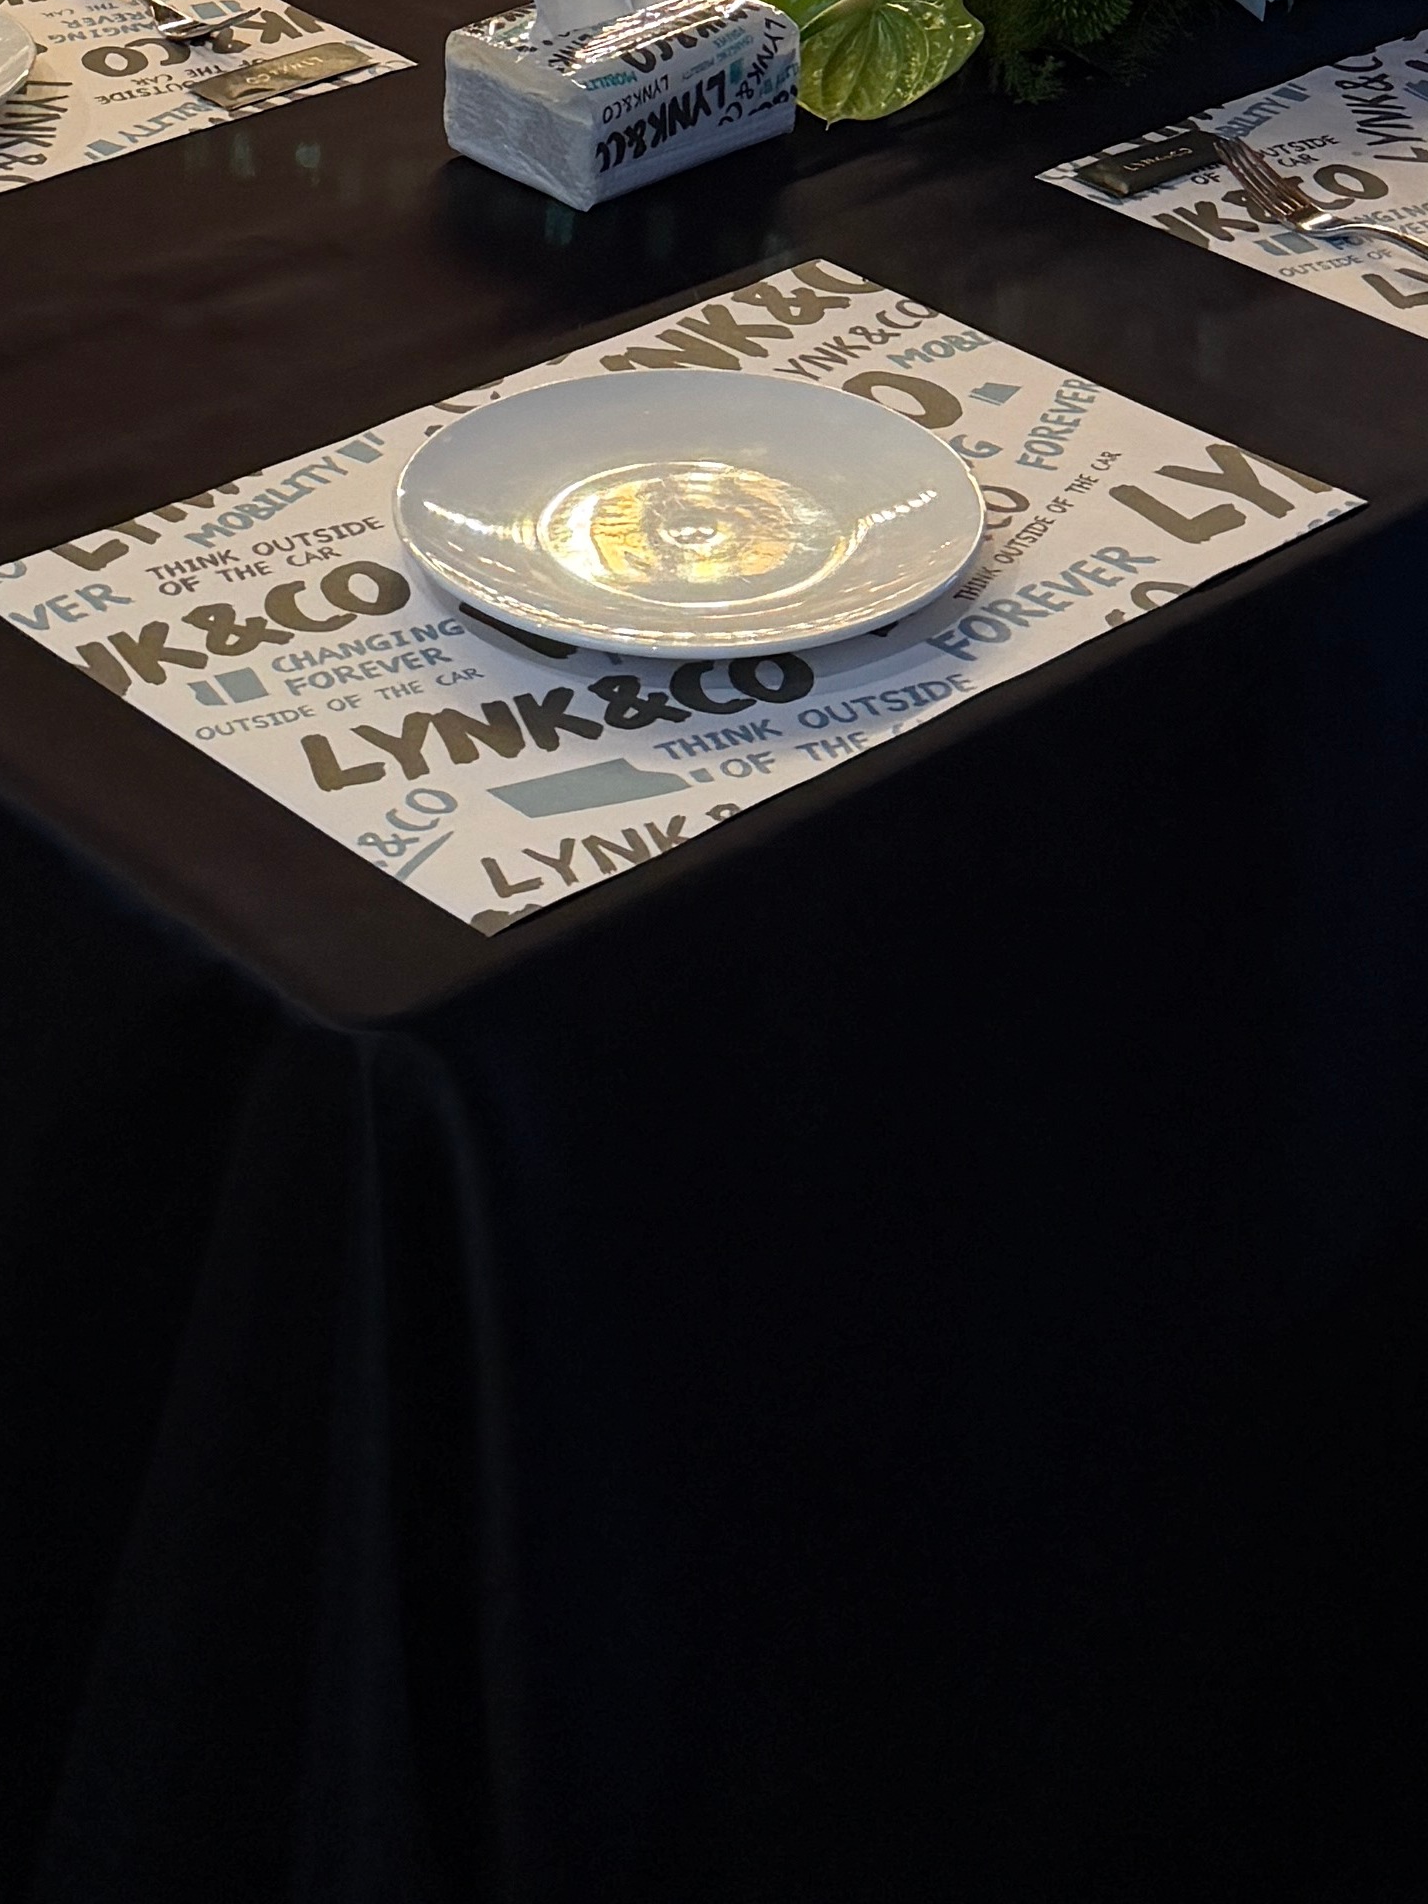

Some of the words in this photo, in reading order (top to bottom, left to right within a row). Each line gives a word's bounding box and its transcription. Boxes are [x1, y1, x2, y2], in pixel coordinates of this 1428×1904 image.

[602, 73, 671, 125] LYNK&CO
[1015, 378, 1100, 472] FOREVER
[184, 455, 351, 549] MOBILITY
[994, 515, 1056, 565] OUTSIDE
[1046, 497, 1075, 515] OF
[1063, 472, 1102, 499] THE
[145, 548, 237, 583] THINK
[251, 515, 386, 557] OUTSIDE
[158, 576, 202, 597] OF
[221, 560, 273, 584] THE
[285, 545, 343, 569] CAR
[926, 545, 1162, 663] FOREVER
[272, 617, 468, 676] CHANGING
[283, 645, 453, 698] FOREVER
[194, 702, 318, 742] OUTSIDE
[326, 691, 364, 714] OF
[373, 678, 425, 704] THE
[436, 665, 487, 689] CAR
[300, 651, 815, 793] LYNK&CO
[654, 718, 783, 763] THINK
[798, 673, 978, 731] OUTSIDE
[719, 750, 777, 782] OF
